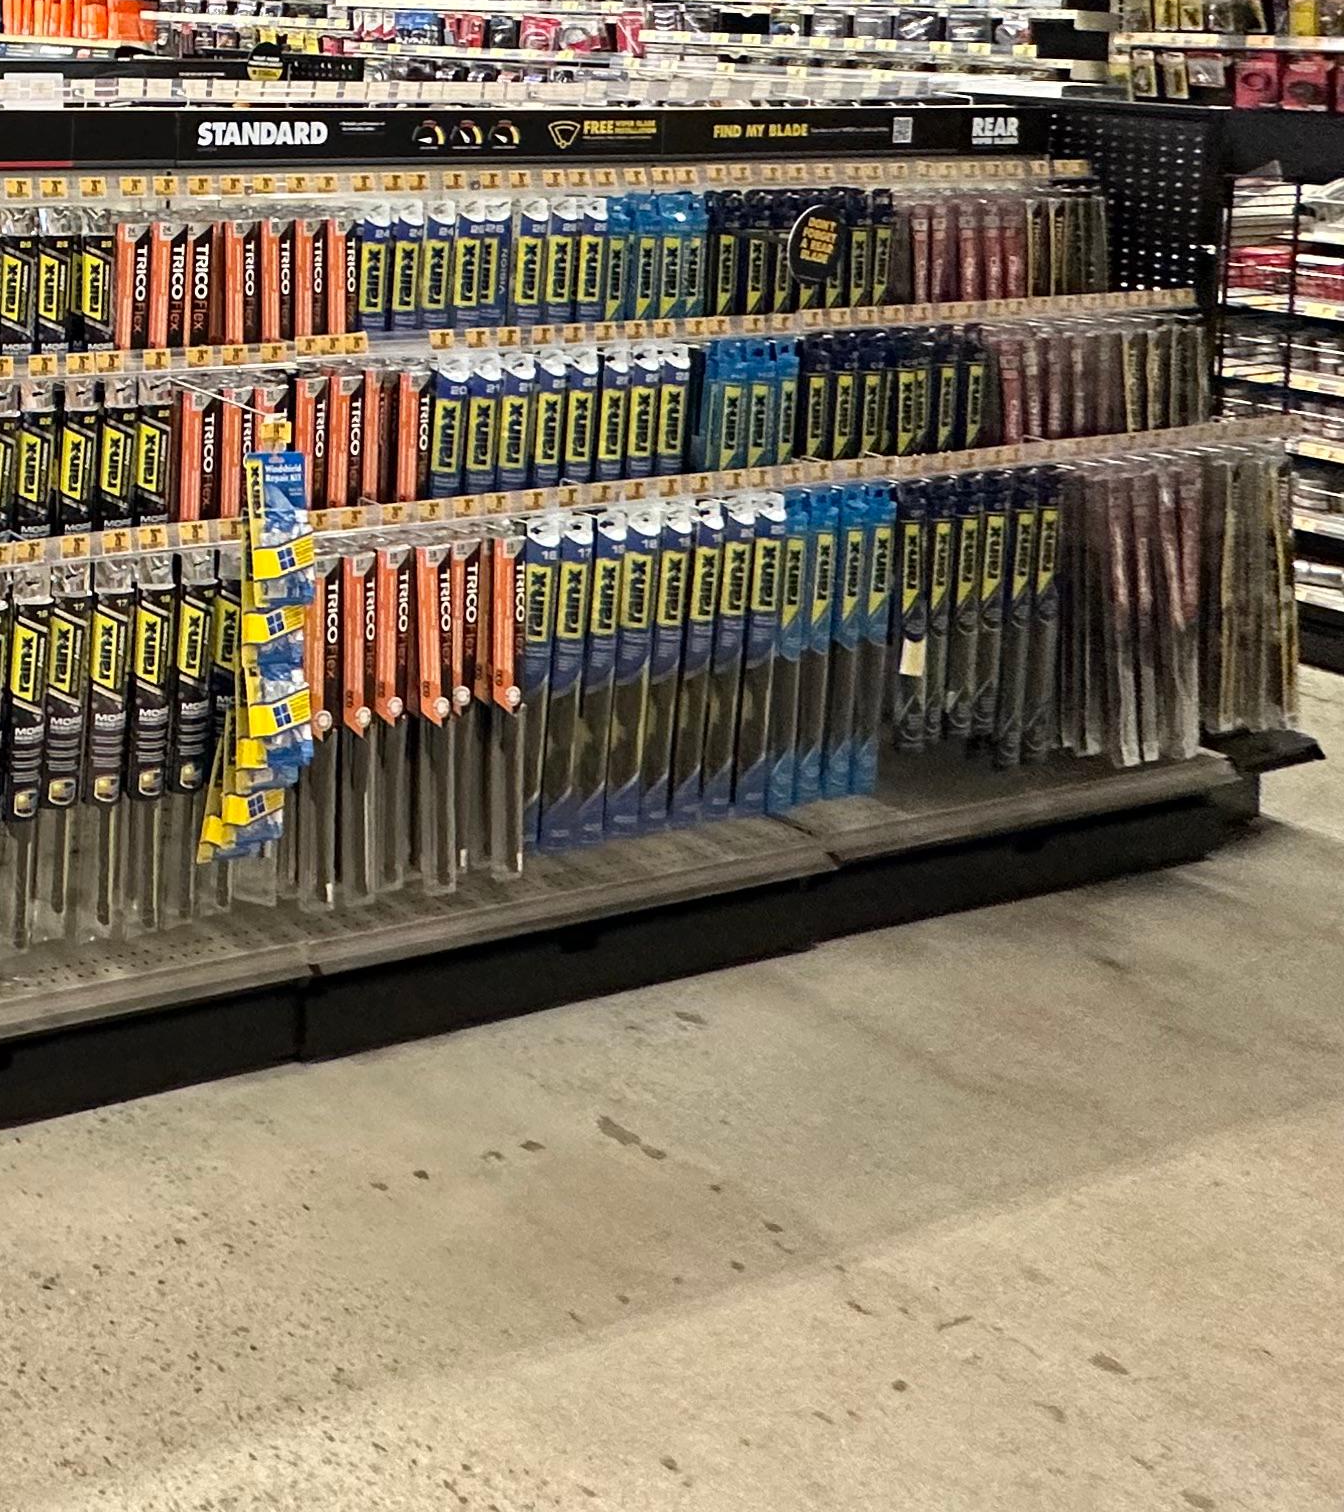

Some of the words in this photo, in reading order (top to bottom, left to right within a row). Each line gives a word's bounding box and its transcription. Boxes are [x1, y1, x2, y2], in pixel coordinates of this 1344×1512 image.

[197, 121, 328, 147] STANDARD
[583, 120, 614, 134] FREE
[714, 125, 741, 138] FIND
[746, 125, 764, 137] MY
[768, 124, 807, 136] BLADE
[972, 117, 1019, 136] REAR
[194, 243, 209, 300] TRICO
[327, 582, 338, 644] TRICO
